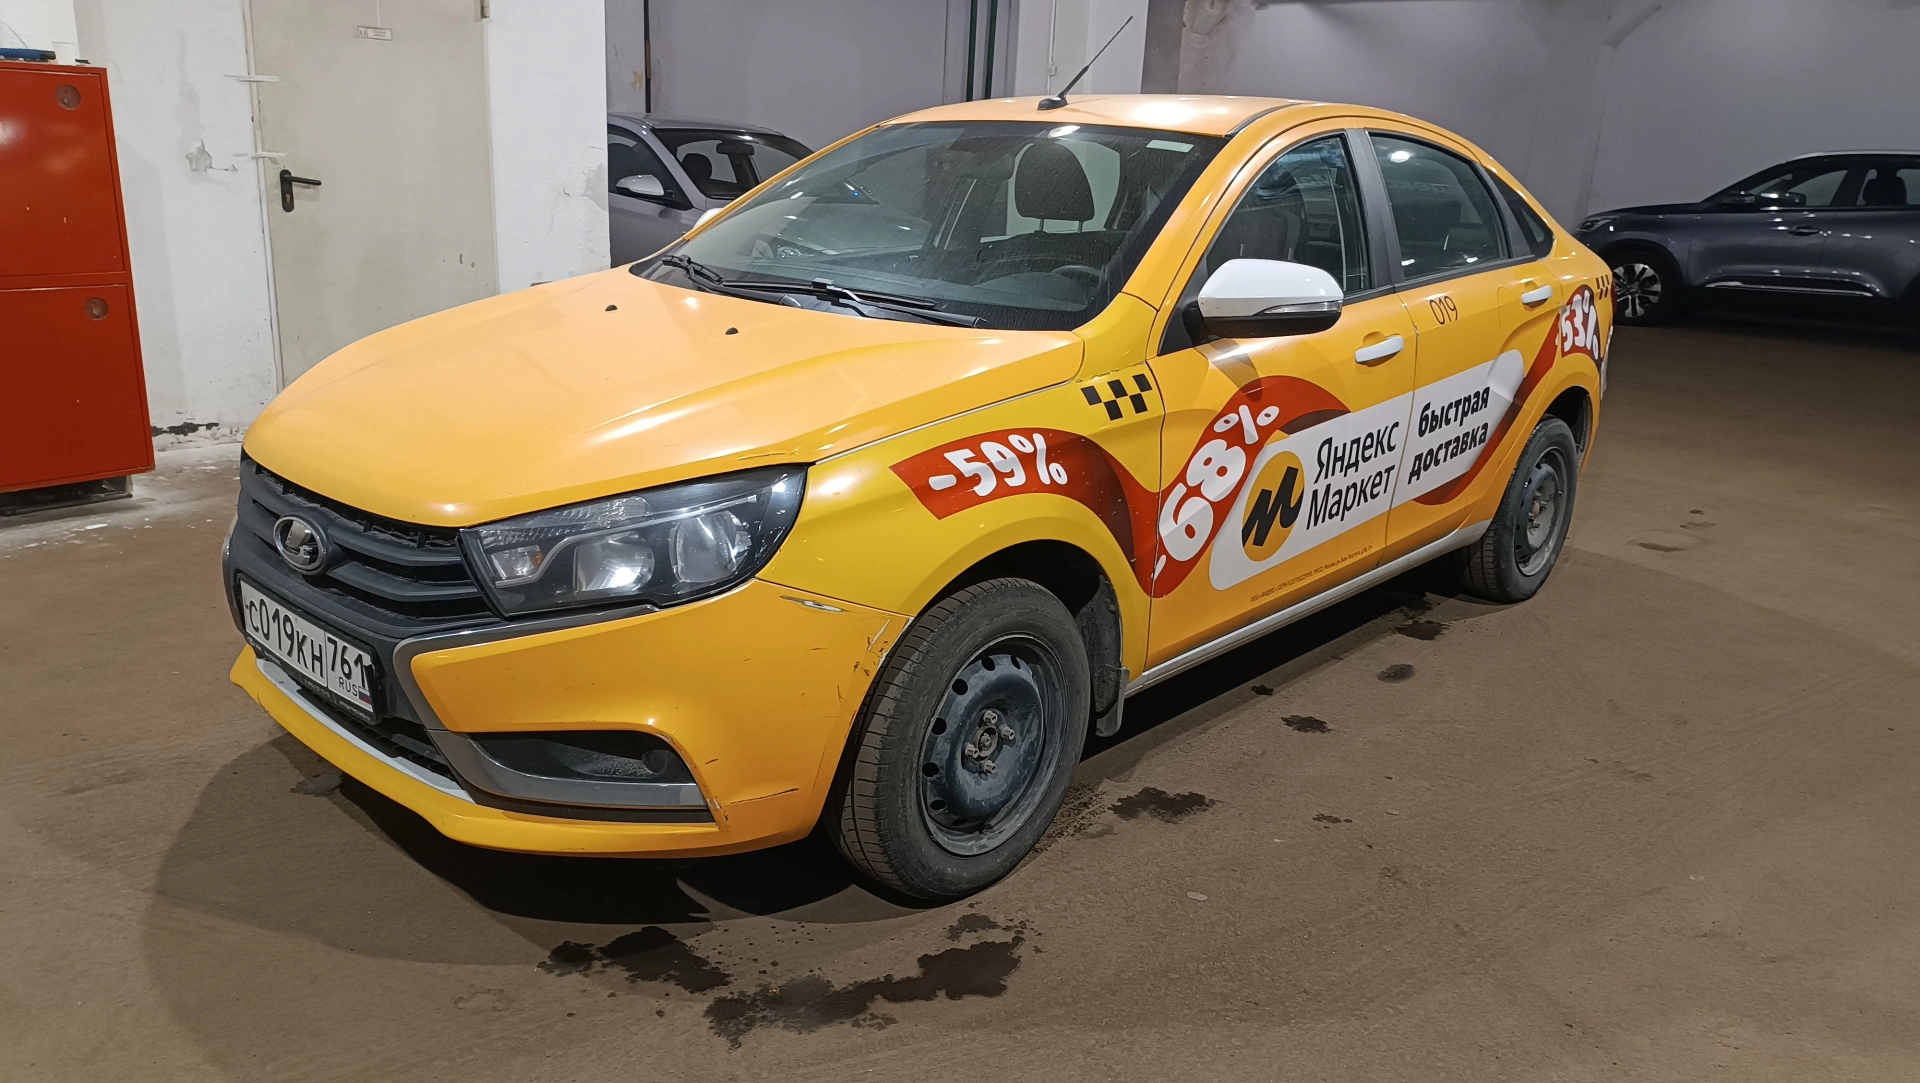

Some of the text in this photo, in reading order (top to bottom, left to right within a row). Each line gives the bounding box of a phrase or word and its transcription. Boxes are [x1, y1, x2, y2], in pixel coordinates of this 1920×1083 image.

[1430, 295, 1458, 325] 019
[1418, 386, 1490, 438] быстрая
[928, 432, 1068, 497] -59%
[1313, 421, 1400, 485] Яндекс
[1407, 422, 1489, 485] доставка
[1305, 464, 1396, 531] Маркет
[338, 676, 358, 697] RUS
